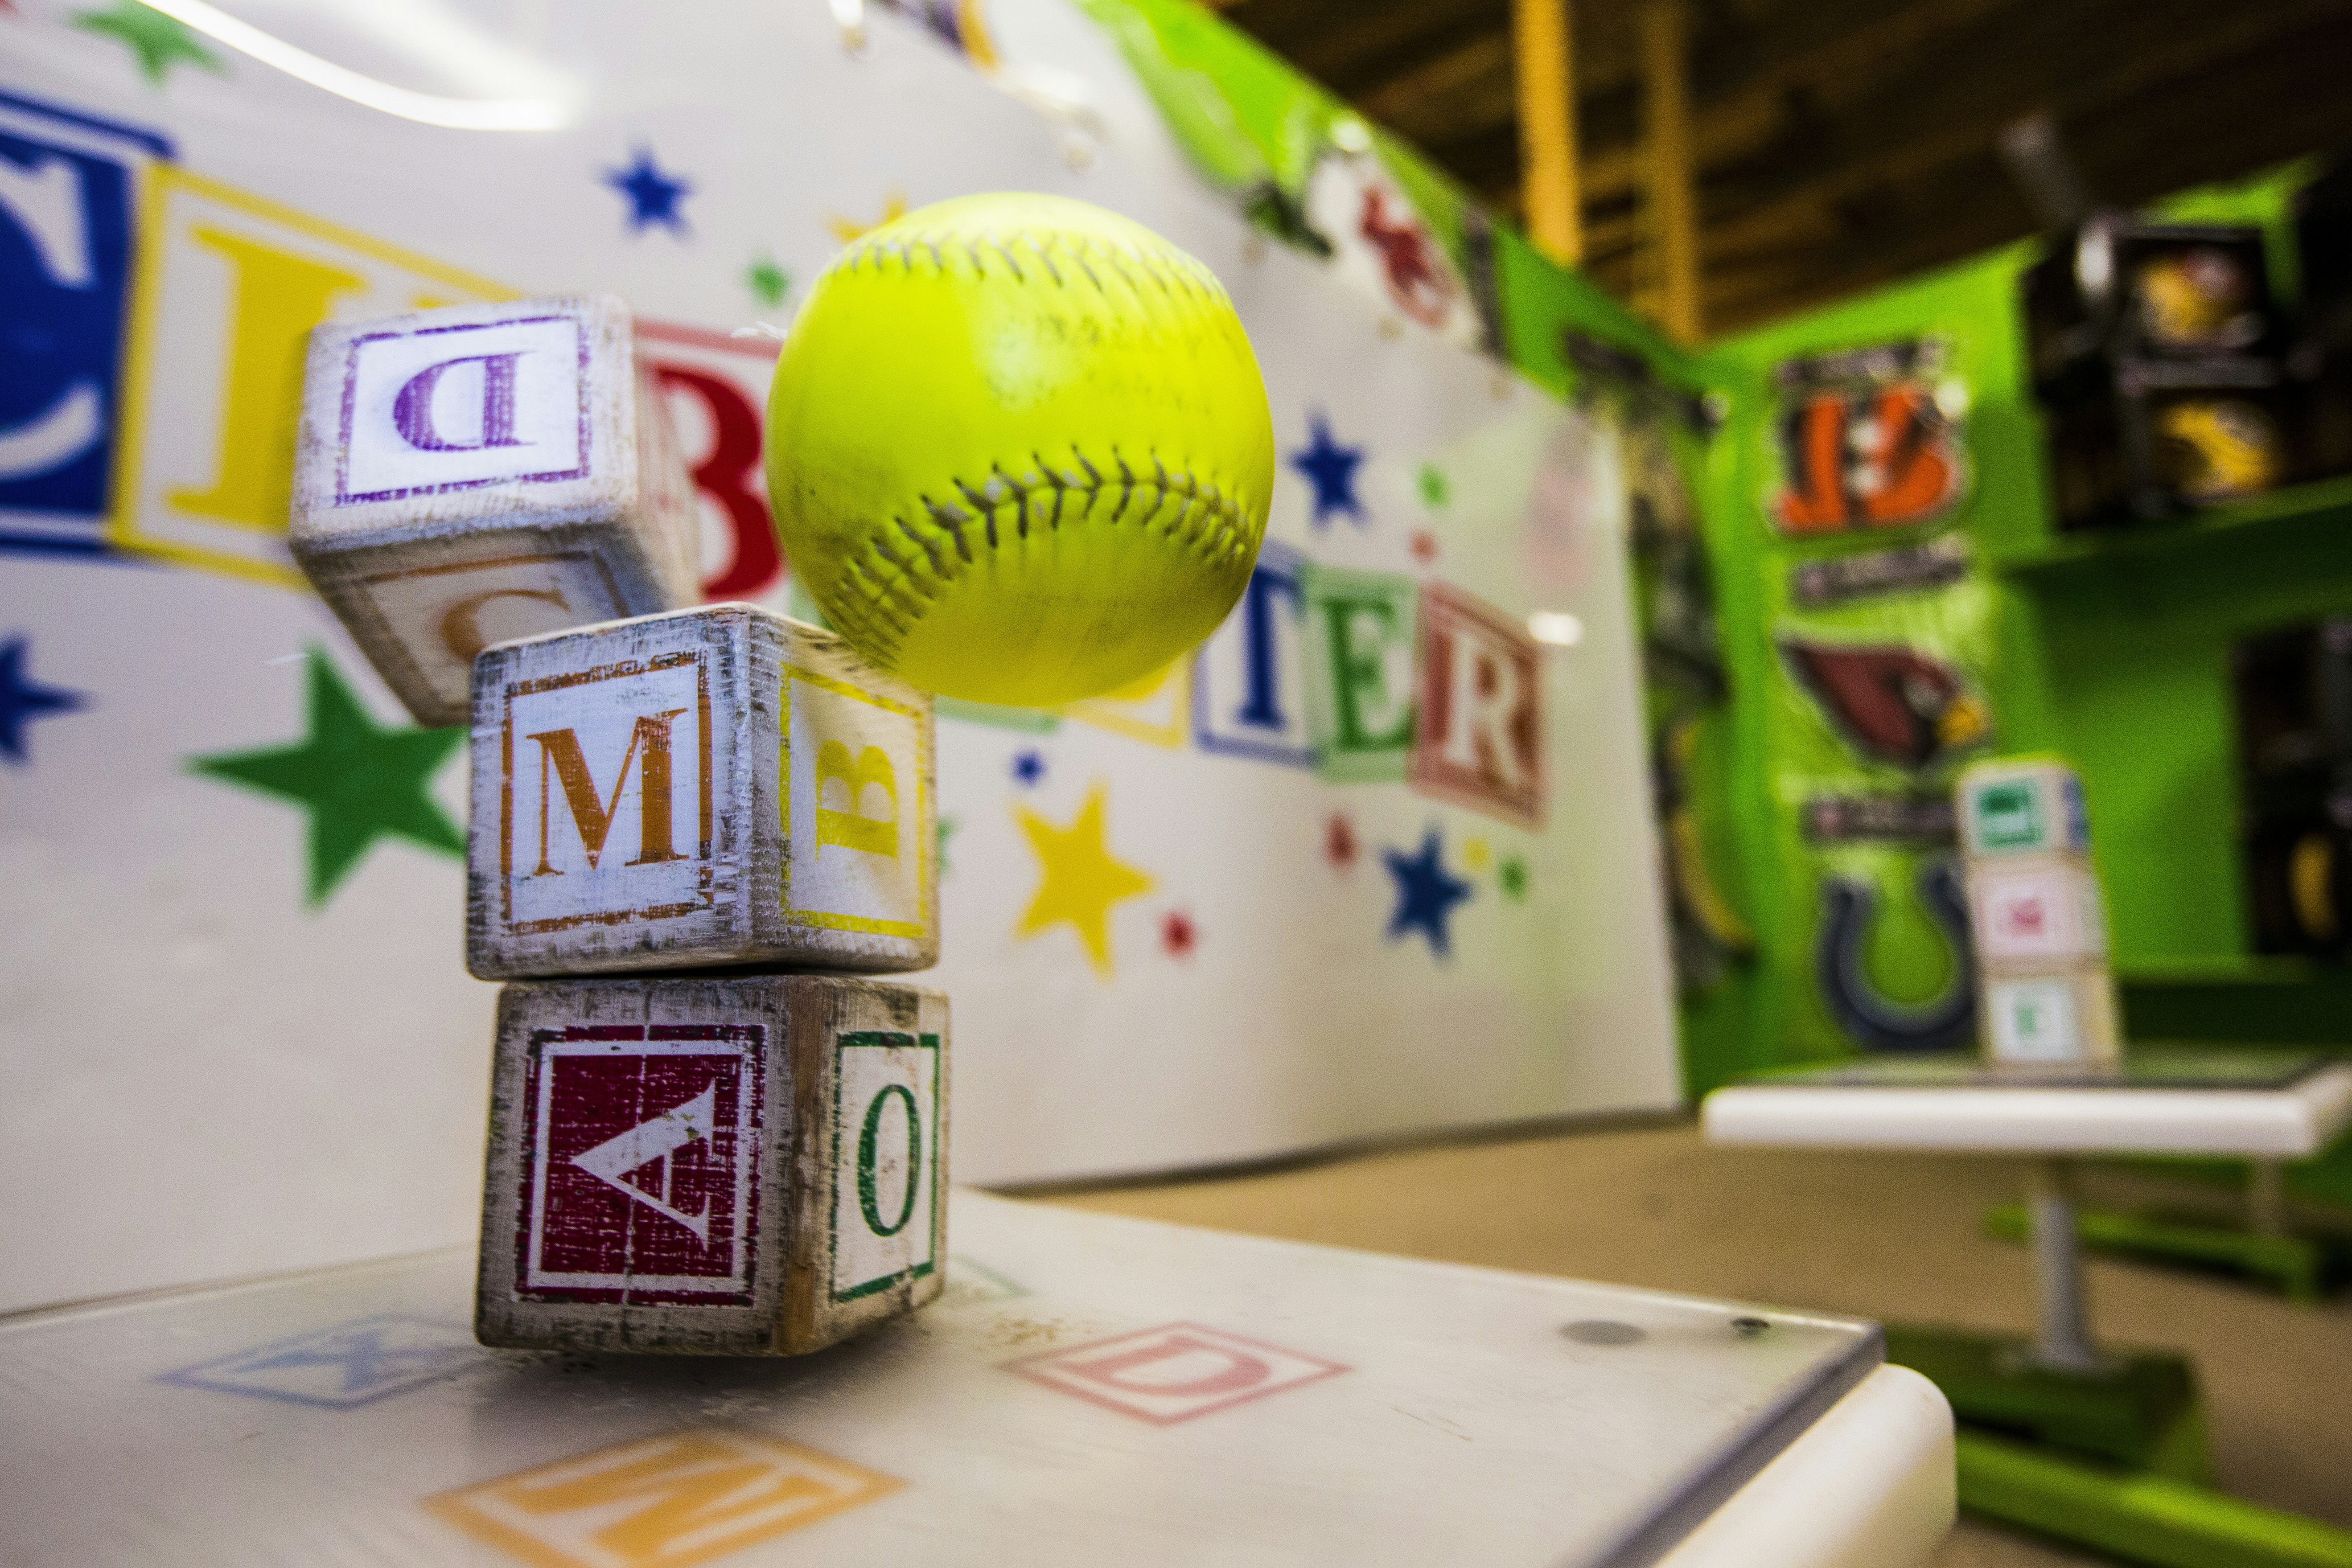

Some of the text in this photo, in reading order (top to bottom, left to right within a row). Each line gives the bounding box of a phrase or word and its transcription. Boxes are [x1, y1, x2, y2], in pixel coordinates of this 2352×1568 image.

[392, 350, 539, 452] D
[526, 708, 689, 876] M
[815, 739, 900, 862] B
[567, 1076, 715, 1252] A
[1051, 1335, 1273, 1396] D
